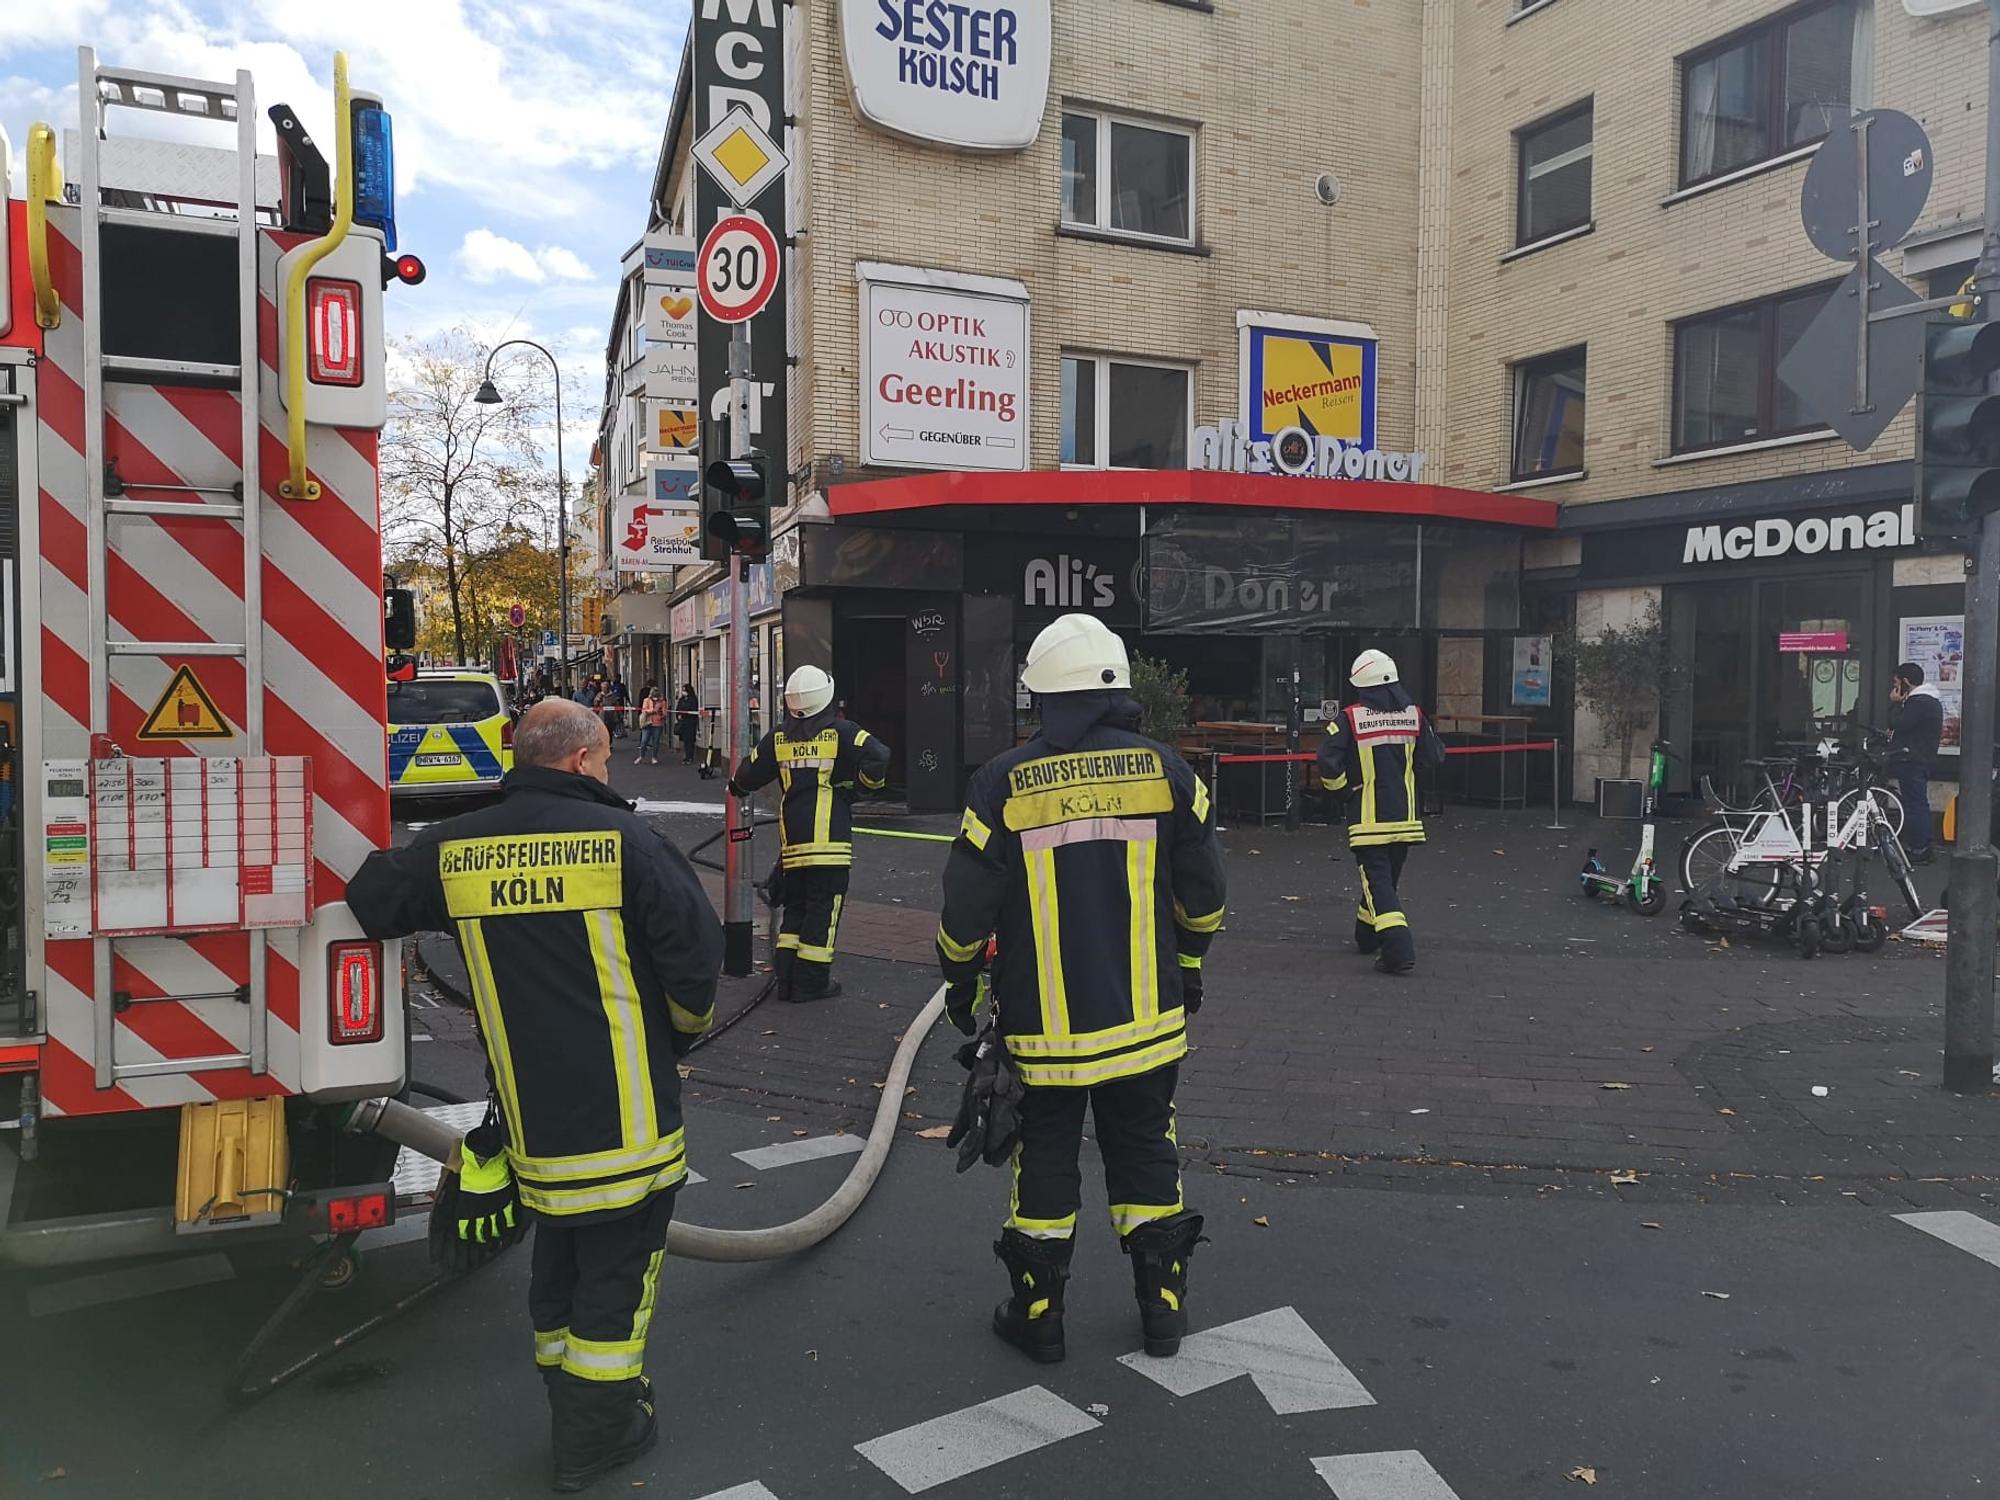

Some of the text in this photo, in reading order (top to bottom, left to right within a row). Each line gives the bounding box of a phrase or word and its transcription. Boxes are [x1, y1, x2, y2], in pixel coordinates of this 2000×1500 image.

[875, 0, 1017, 65] SESTER
[900, 48, 999, 100] KÖLSCH
[712, 246, 759, 293] 30
[661, 320, 693, 330] Thomas
[666, 329, 687, 338] Cook
[917, 312, 986, 338] OPTIK
[908, 339, 1001, 367] AKUSTIK
[649, 363, 696, 376] JAHN
[879, 373, 1016, 422] Geerling
[1263, 374, 1361, 408] Neckermann
[1322, 393, 1354, 409] Reisen
[919, 430, 981, 446] GEGENÜBER
[1683, 504, 1915, 564] McDonal
[653, 544, 692, 554] Strohhut
[1024, 555, 1115, 607] Ali's
[389, 733, 420, 743] LIZEI
[1358, 719, 1416, 730] BERUFSFEUERWEHR
[793, 744, 818, 757] KÖLN
[1014, 753, 1156, 791] BERUFSFEUERWEHR
[1059, 789, 1122, 816] KÖLN
[443, 838, 616, 874] BERUFSFEUERWEHR
[491, 872, 564, 908] KÖLN
